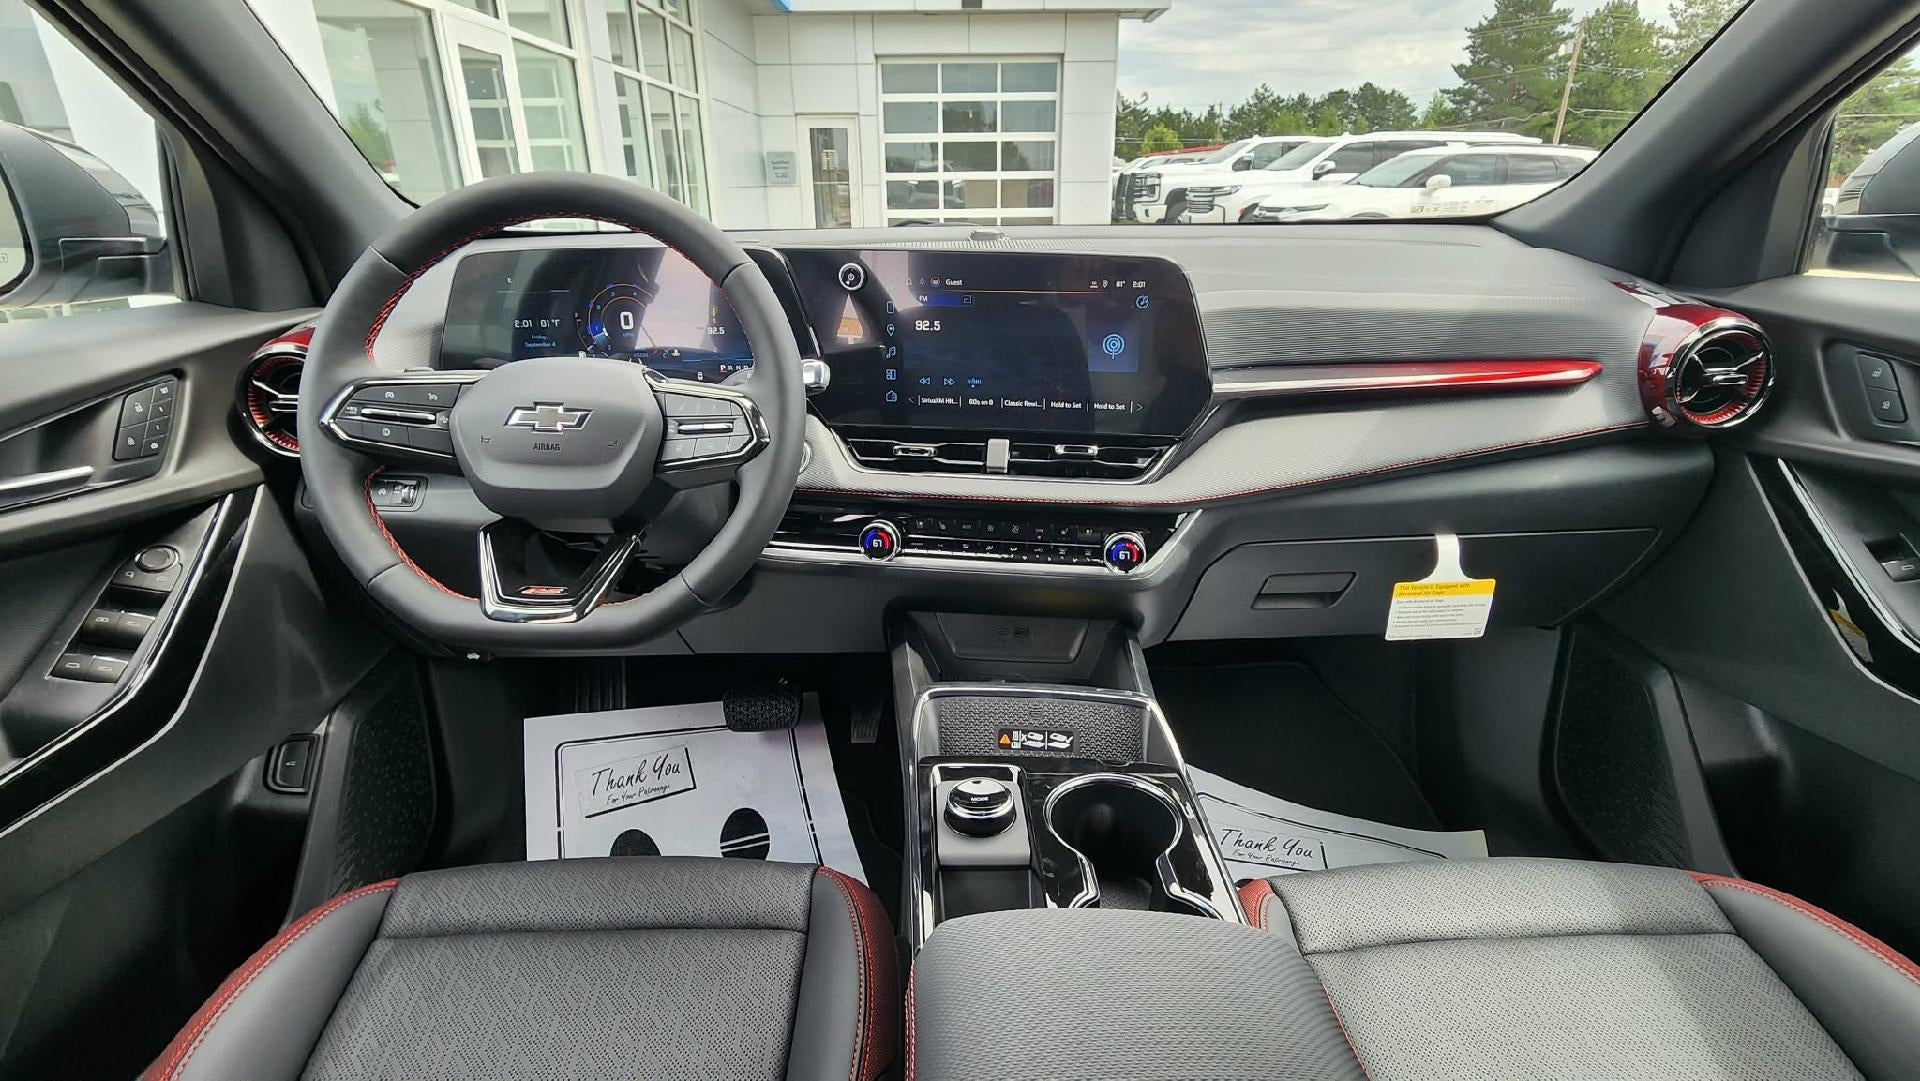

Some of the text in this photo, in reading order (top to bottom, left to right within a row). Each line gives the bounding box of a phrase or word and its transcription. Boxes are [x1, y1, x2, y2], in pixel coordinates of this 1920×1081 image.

[945, 278, 963, 286] Guest
[1132, 280, 1146, 288] 2:01
[620, 311, 634, 330] 0
[915, 320, 941, 331] 92.5
[707, 326, 725, 335] 92.5
[525, 341, 551, 349] September
[1004, 399, 1023, 407] Classic
[1093, 402, 1108, 410] Hold
[1116, 403, 1126, 411] Set
[533, 442, 561, 452] AIRBAG
[872, 539, 883, 548] 67
[1118, 550, 1131, 560] 67
[591, 753, 681, 797] Thank You
[606, 793, 619, 805] For
[621, 790, 637, 802] Your
[1220, 828, 1313, 859] Thank You
